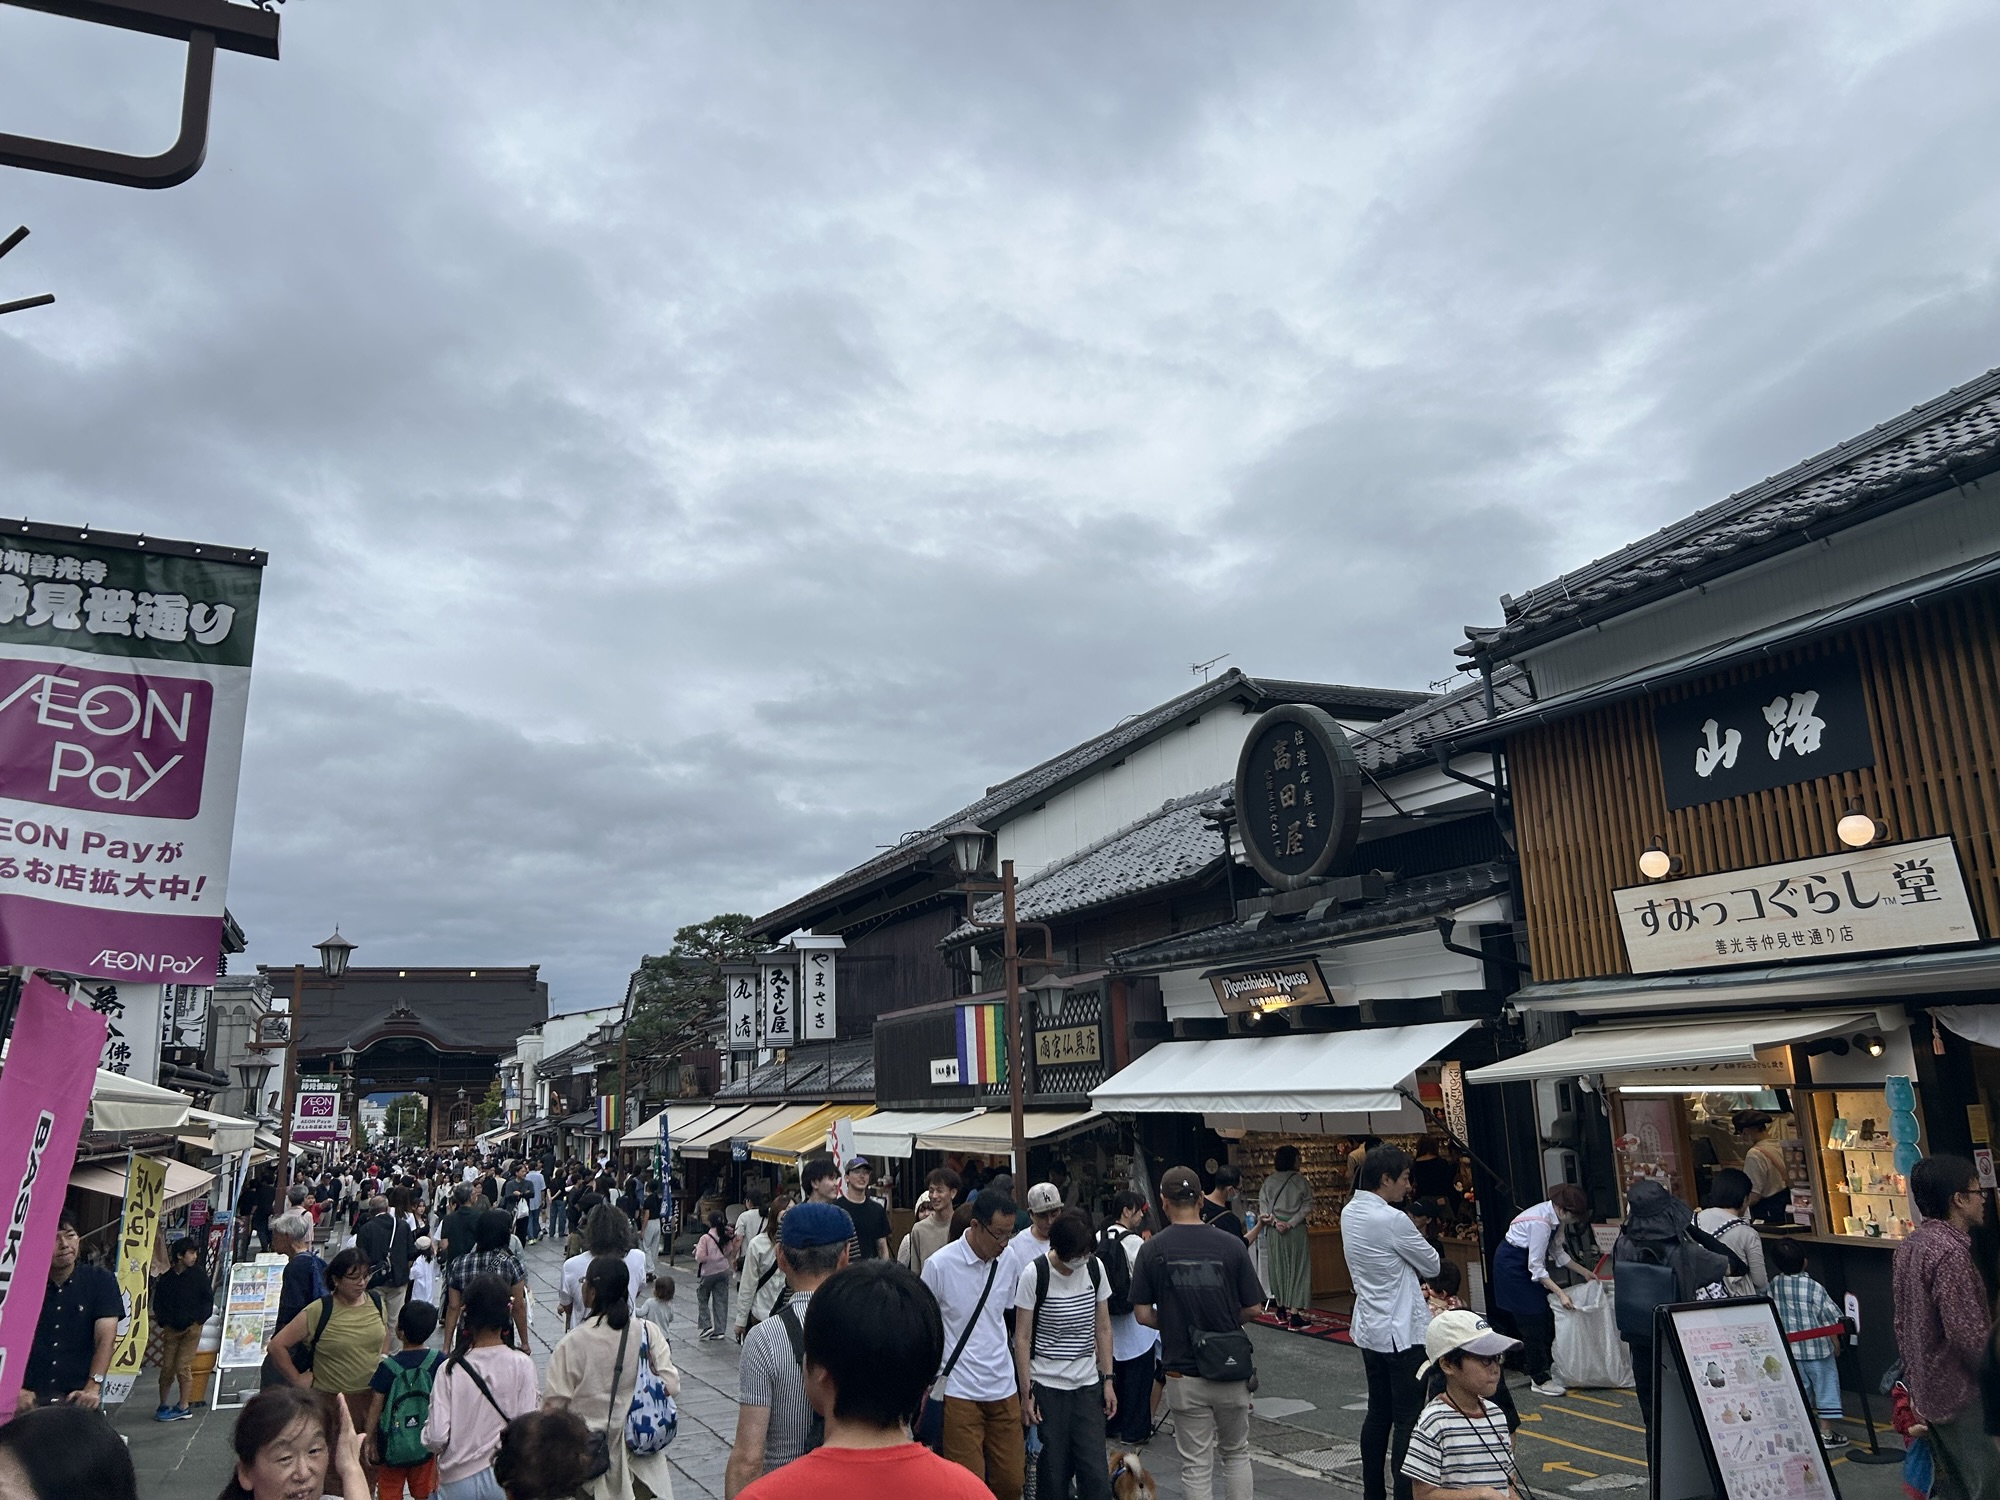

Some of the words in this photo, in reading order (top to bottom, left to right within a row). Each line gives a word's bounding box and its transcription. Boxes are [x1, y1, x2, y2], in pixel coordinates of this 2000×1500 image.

[0, 549, 107, 584] 州善光寺
[1695, 690, 1826, 777] 山路
[48, 741, 183, 801] Pay
[1273, 740, 1303, 855] 高田屋
[1715, 924, 1854, 955] 善光寺仲見世通り店
[159, 954, 204, 975] Pay
[1222, 971, 1275, 999] Monchhichi
[1273, 971, 1309, 993] House
[733, 979, 752, 1037] 丸清
[770, 969, 790, 1033] みよし屋
[811, 953, 829, 1028] やまさき
[1040, 1029, 1096, 1060] 雨宮仏具店
[312, 1107, 330, 1115] Pay
